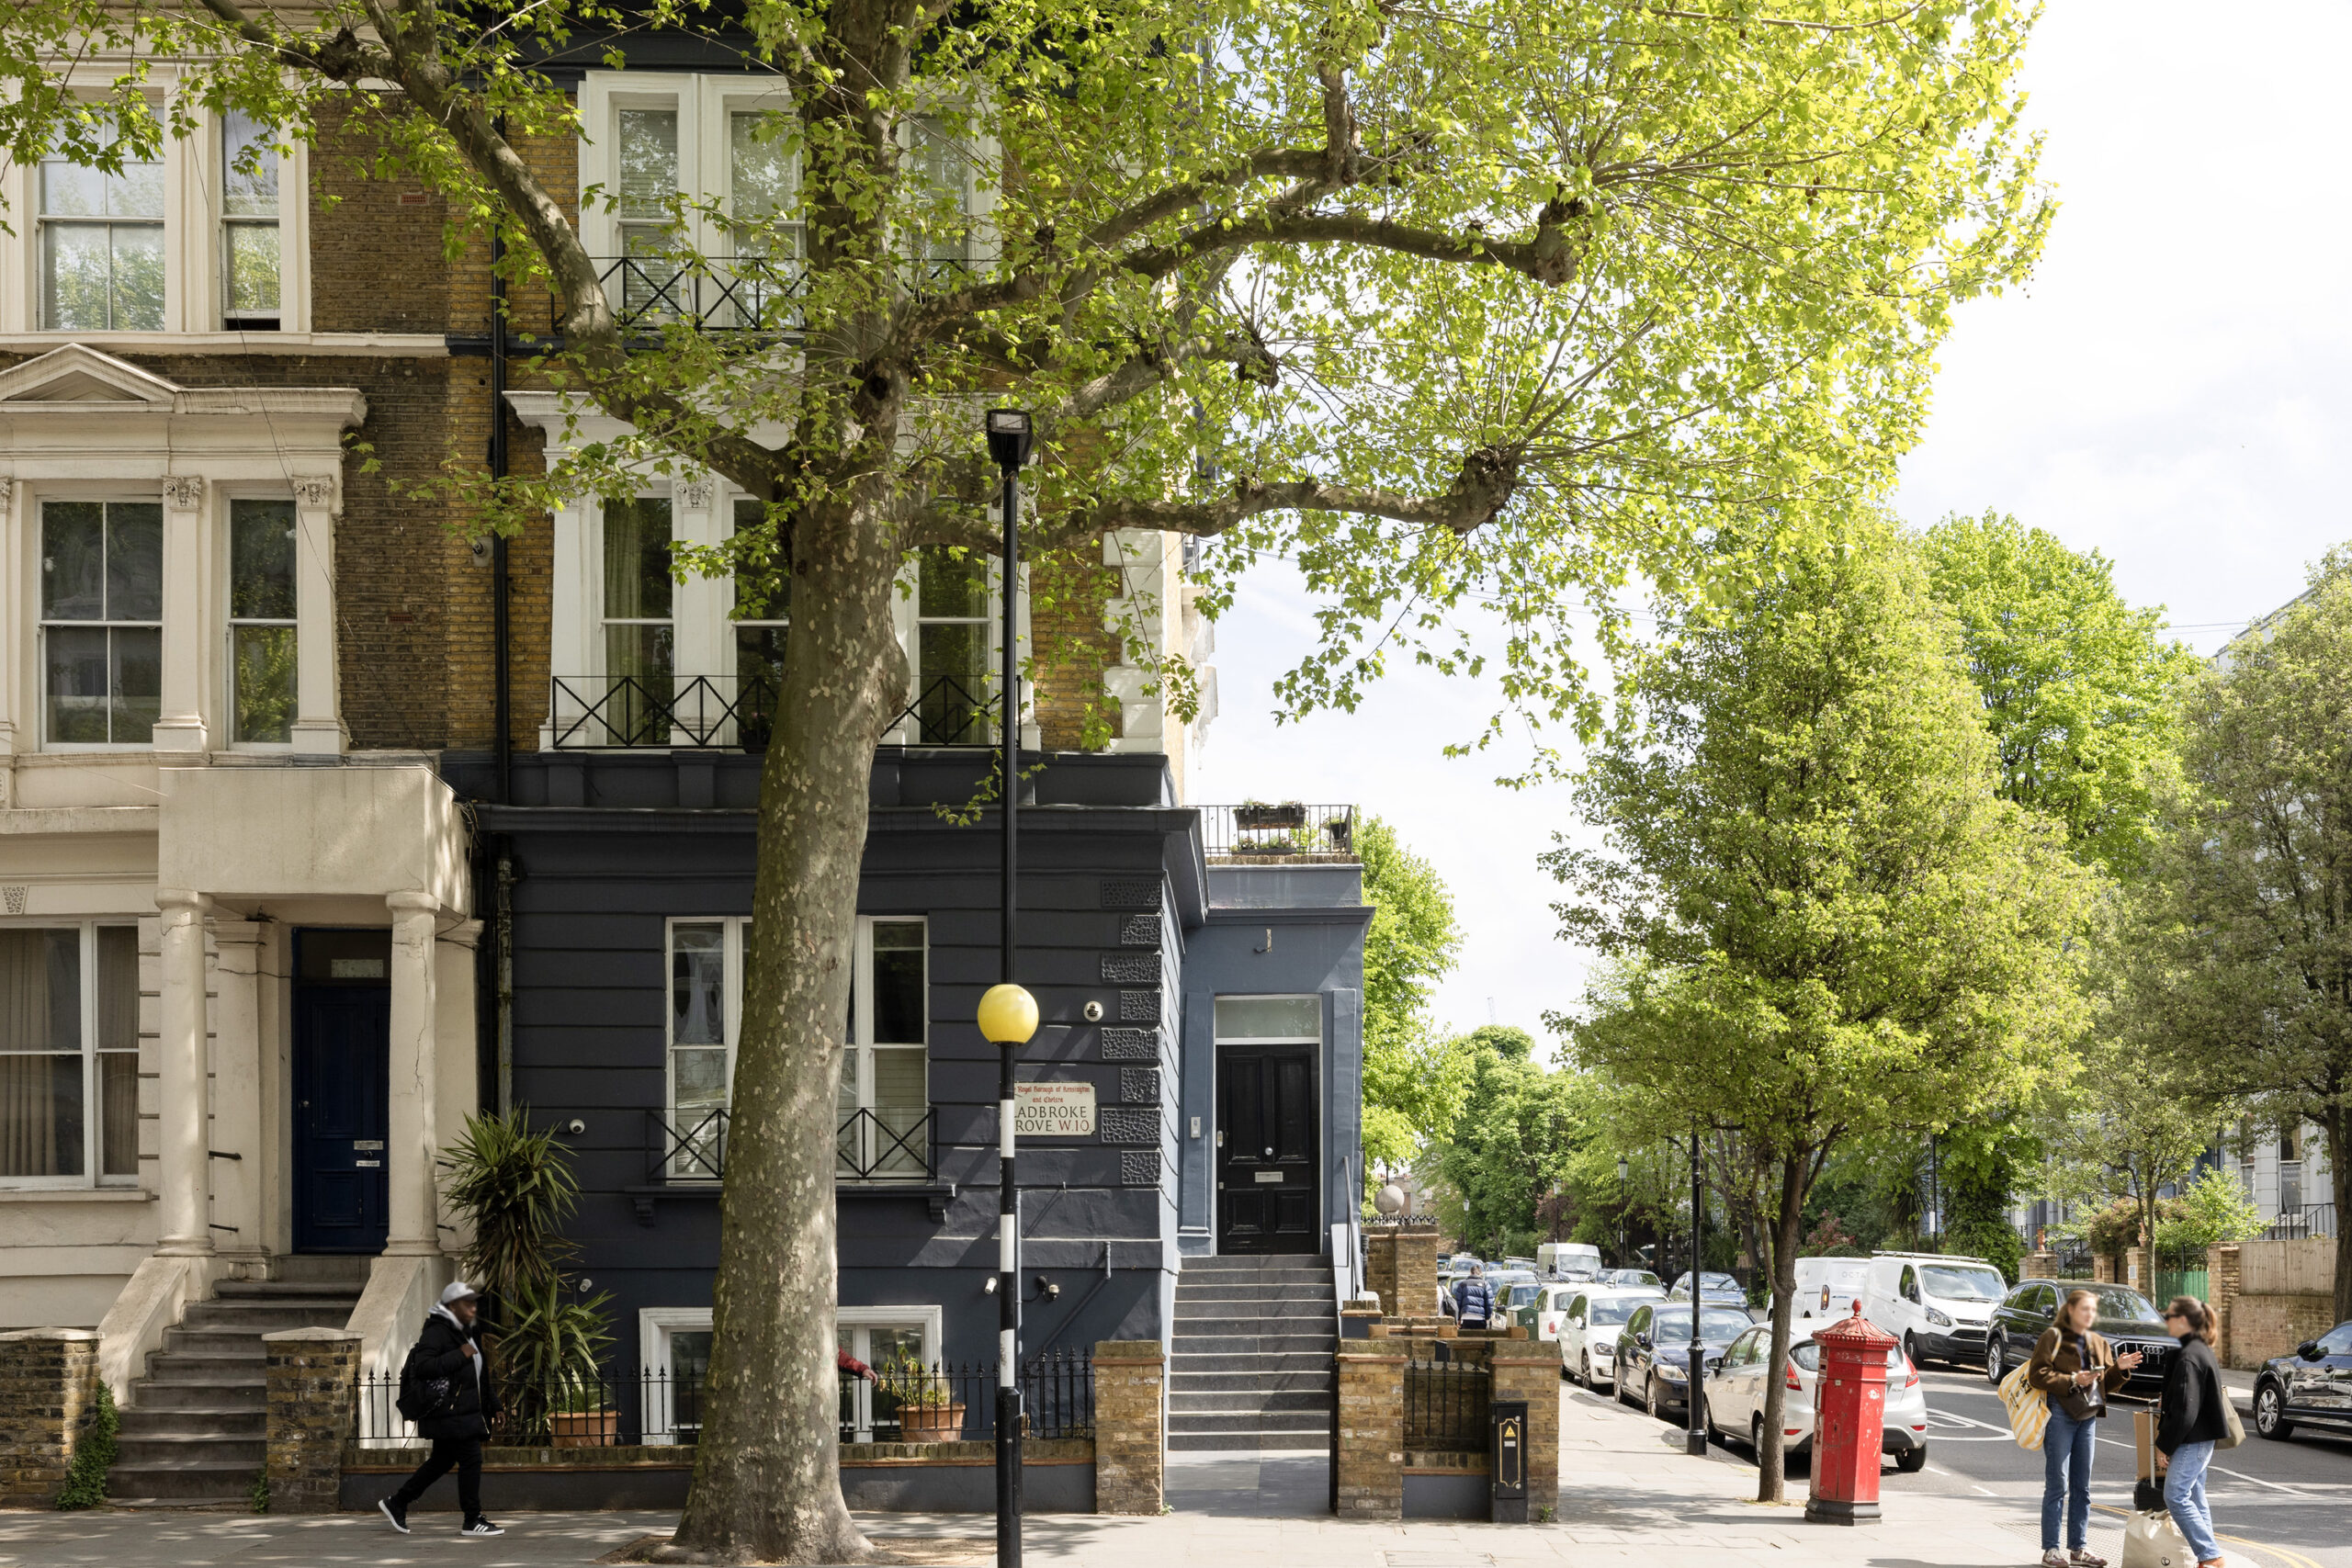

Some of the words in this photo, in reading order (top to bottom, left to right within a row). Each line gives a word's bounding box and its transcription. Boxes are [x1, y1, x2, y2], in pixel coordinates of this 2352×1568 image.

[1034, 1086, 1054, 1094] Borough
[1063, 1086, 1091, 1094] Kensington
[1014, 1106, 1087, 1118] ADBROKE
